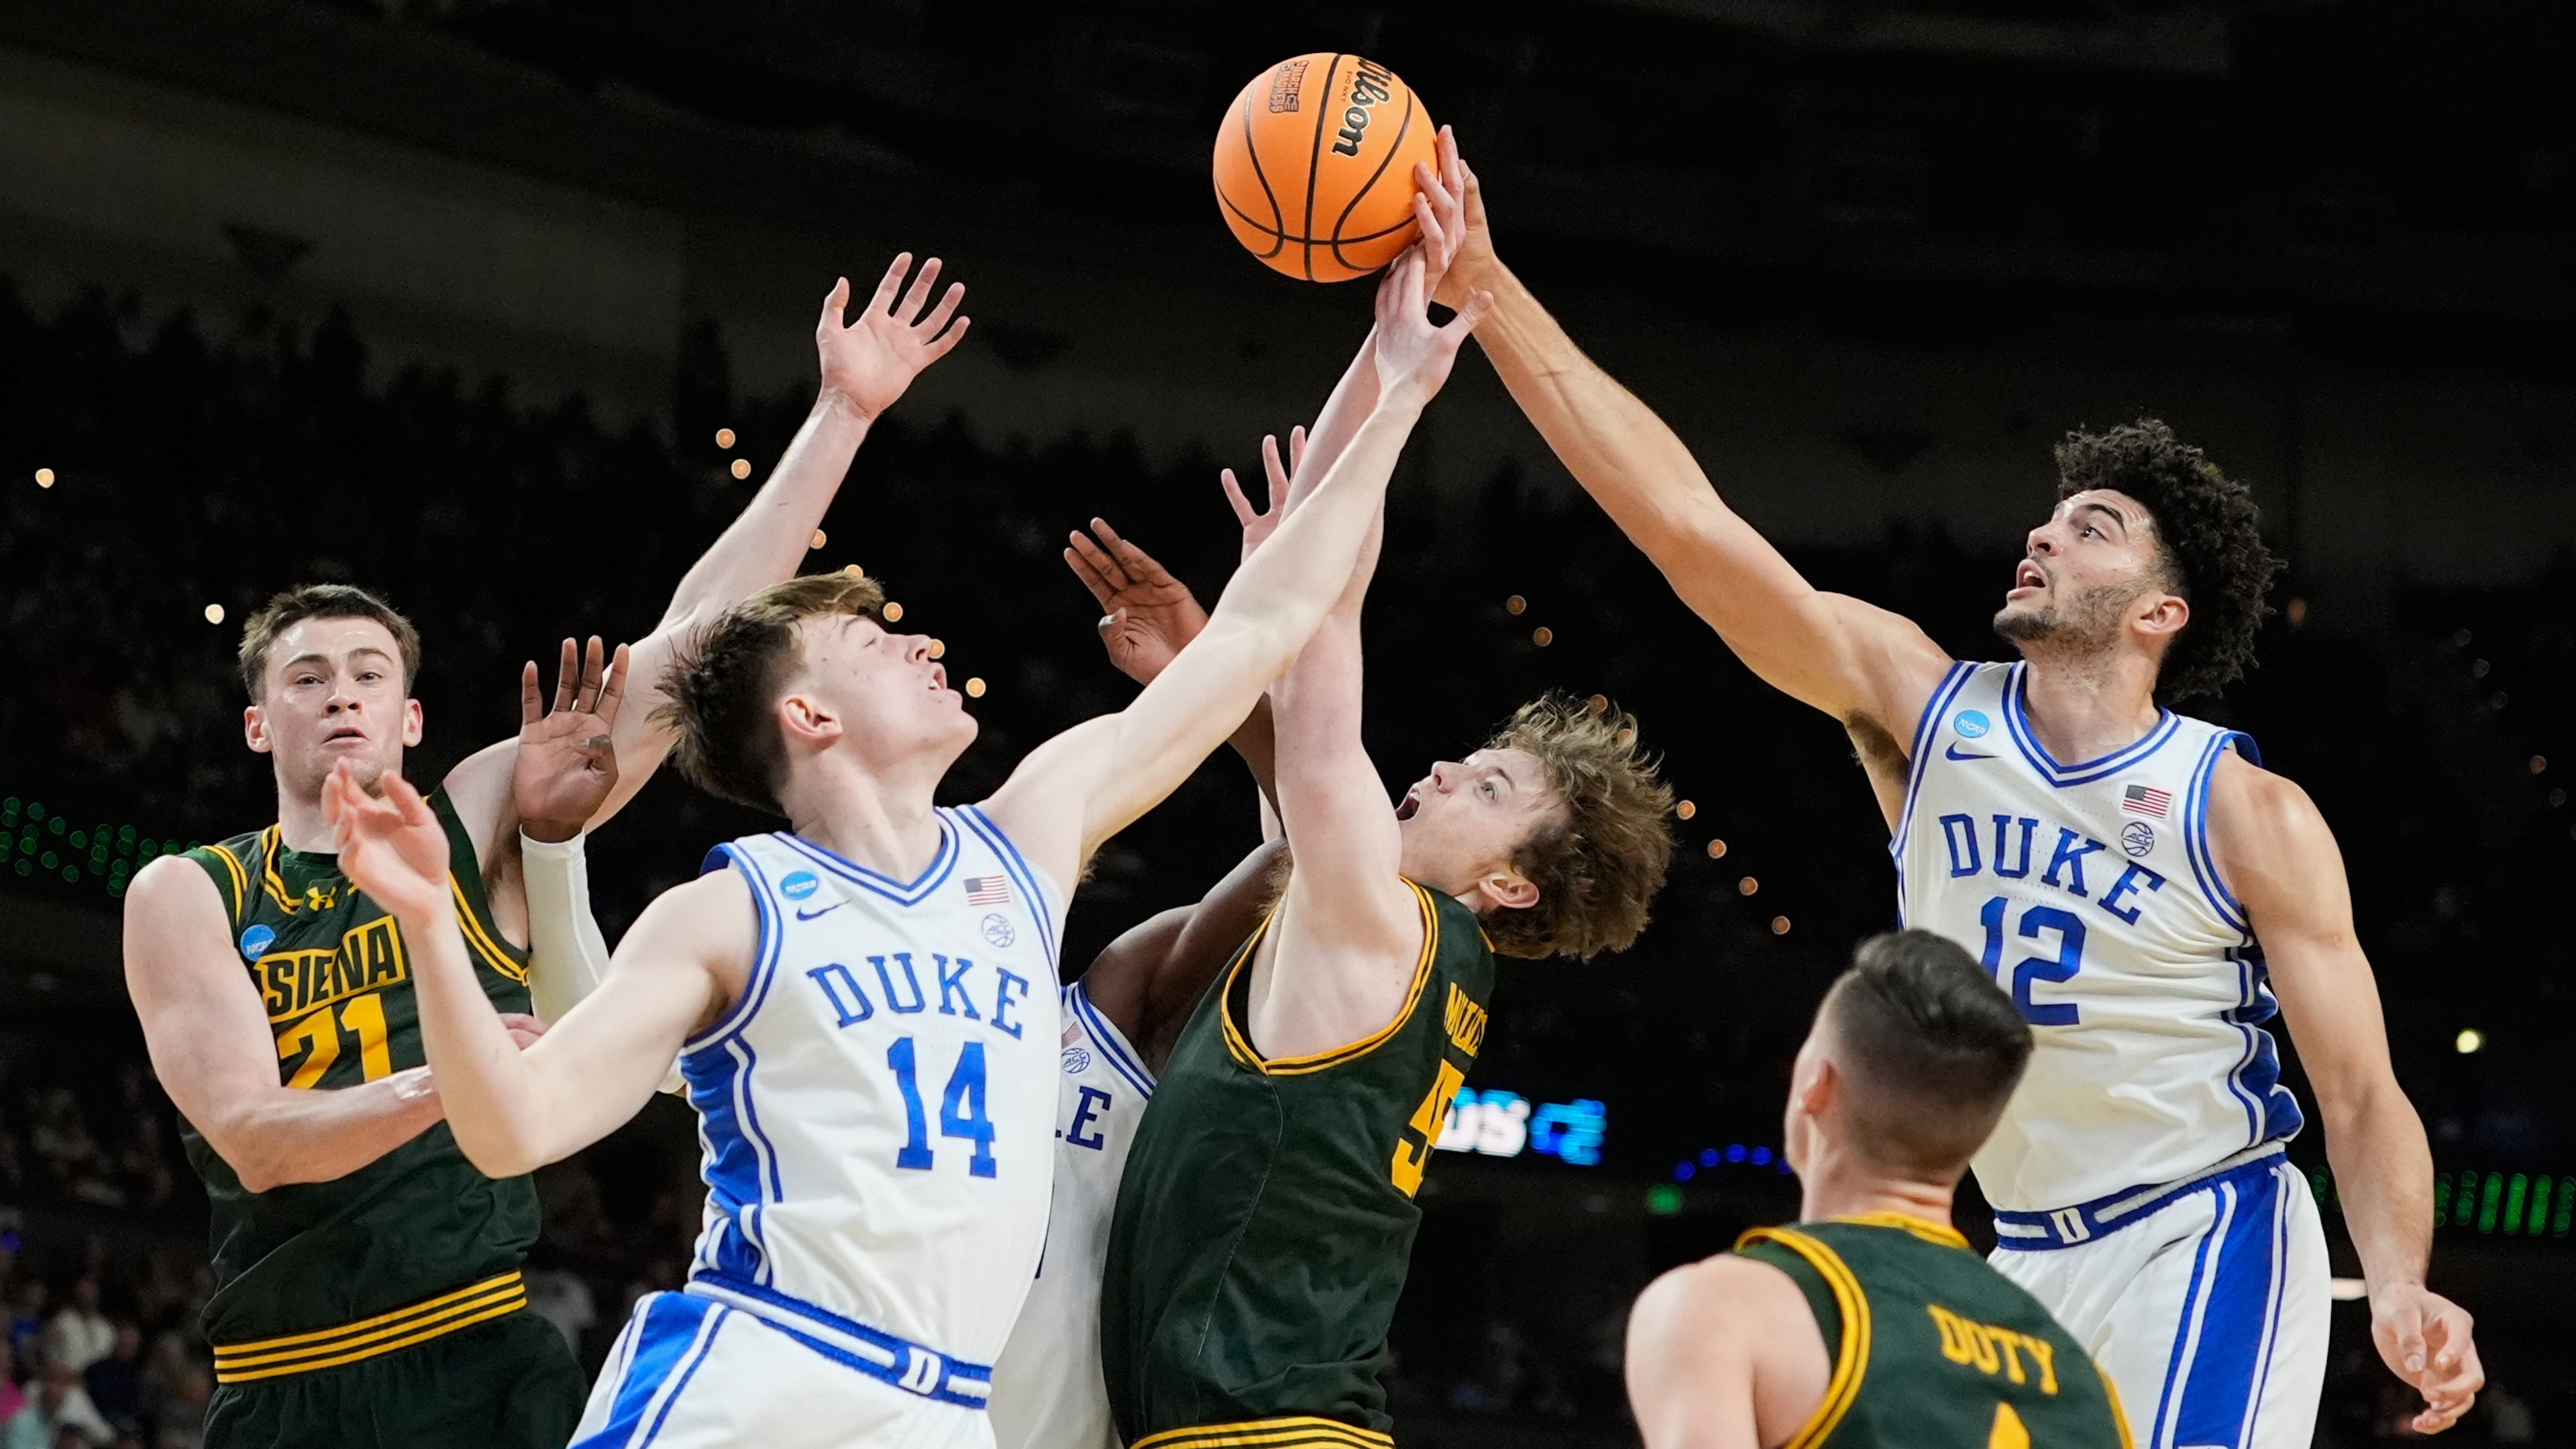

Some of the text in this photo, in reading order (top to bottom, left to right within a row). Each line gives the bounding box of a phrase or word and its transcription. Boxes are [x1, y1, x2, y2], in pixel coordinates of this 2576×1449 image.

[1331, 58, 1393, 157] Wilson
[1939, 812, 2167, 926] DUKE
[2126, 833, 2153, 845] ACC
[266, 917, 402, 1020] SIENA
[806, 953, 1029, 1040] DUKE
[1980, 896, 2086, 1025] 12
[277, 993, 392, 1090] 21
[887, 1036, 997, 1179] 14
